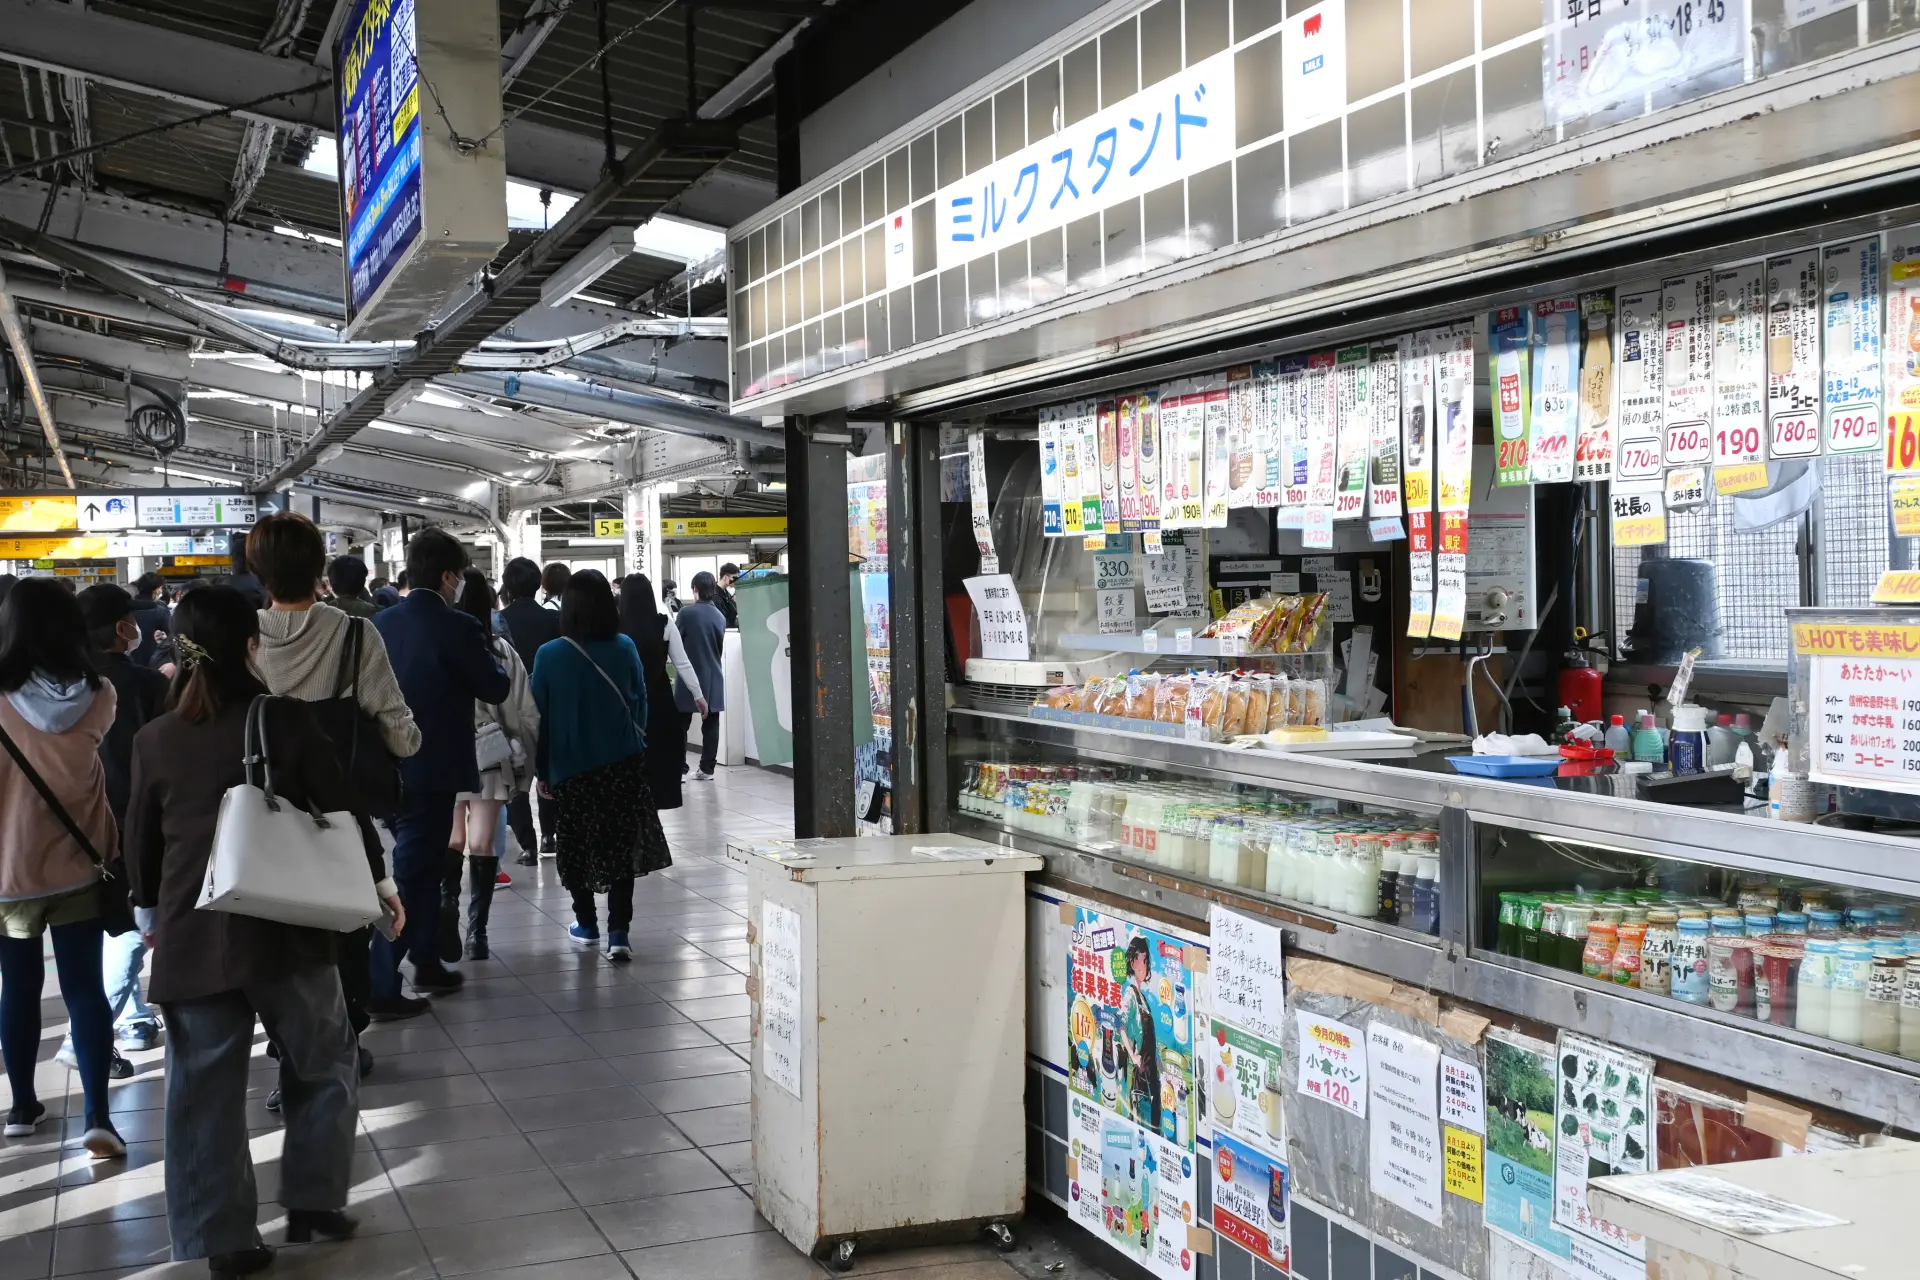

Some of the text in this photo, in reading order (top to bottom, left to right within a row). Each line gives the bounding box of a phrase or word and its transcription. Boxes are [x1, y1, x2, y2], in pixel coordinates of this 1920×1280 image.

[951, 83, 1208, 243] ミルクスタンド
[1463, 337, 1473, 386] 関東初
[1502, 391, 1518, 405] 牛乳
[1769, 384, 1800, 399] ミルク
[1826, 387, 1882, 404] のむヨーグルト
[1790, 395, 1819, 410] コーヒー
[1775, 420, 1817, 444] 180円
[1831, 414, 1878, 441] 190円
[1668, 429, 1709, 452] 160円
[1716, 426, 1760, 456] 190
[1624, 449, 1660, 469] 170円
[1373, 489, 1398, 505] 210円
[1406, 479, 1429, 501] 250円
[1672, 487, 1703, 502] あります
[208, 497, 213, 506] 2
[1337, 495, 1361, 512] 210円
[1613, 495, 1652, 518] 社長の
[600, 520, 610, 536] 5
[1412, 512, 1426, 529] 数量
[1443, 512, 1461, 530] 数量
[1413, 534, 1427, 549] 限定
[1444, 534, 1461, 550] 限定
[1808, 628, 1920, 654] HOTも美味し
[1825, 713, 1844, 725] フルヤ
[1852, 713, 1895, 730] かずさ牛乳
[1824, 733, 1844, 745] 大山
[1855, 751, 1895, 768] コーヒー
[1072, 946, 1105, 976] ご当地牛乳
[1071, 967, 1123, 1010] 結果発表
[1076, 1012, 1092, 1041] 1位
[1313, 1025, 1351, 1049] 今月の特売
[1372, 1033, 1389, 1048] お客様
[1318, 1042, 1349, 1063] ヤマザキ
[1236, 1053, 1259, 1072] 白バラ
[1305, 1053, 1362, 1084] 小倉パン
[1235, 1064, 1261, 1089] フルーツ
[1306, 1078, 1321, 1094] 特価
[1323, 1079, 1350, 1106] 120
[1446, 1097, 1477, 1114] 240円とな
[1447, 1166, 1477, 1184] 250円とな
